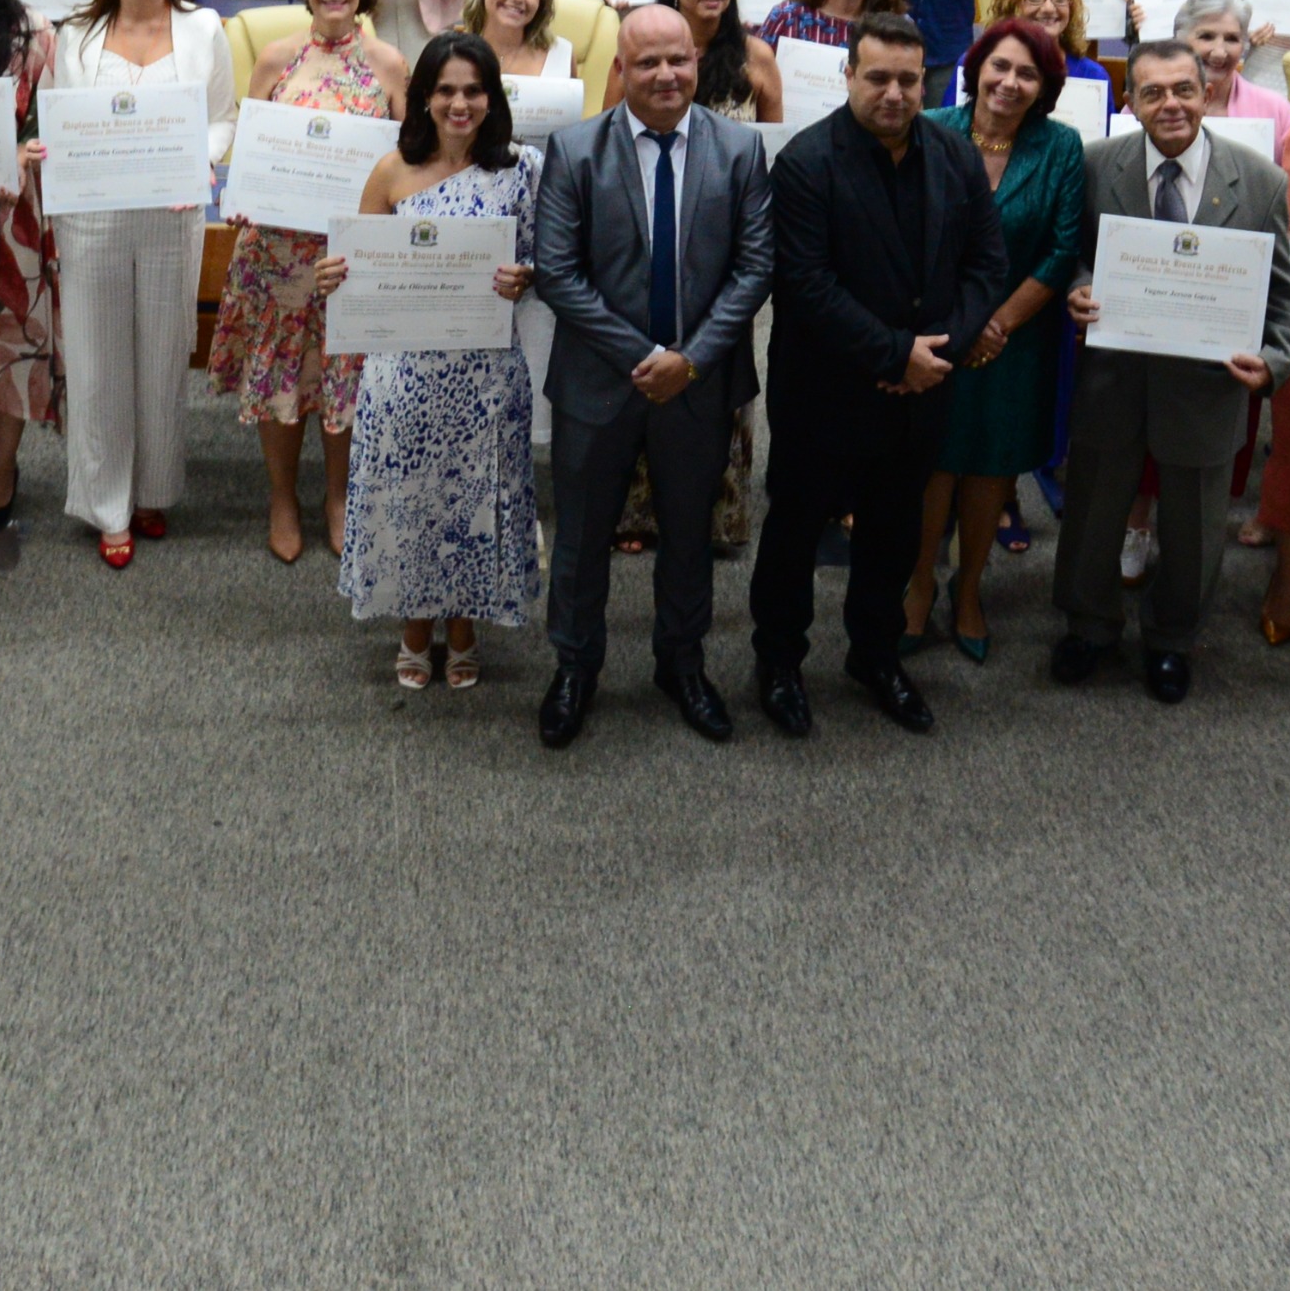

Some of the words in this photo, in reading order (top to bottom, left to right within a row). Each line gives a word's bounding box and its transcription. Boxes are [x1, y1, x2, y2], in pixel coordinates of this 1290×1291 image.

[62, 119, 98, 129] Diploma
[113, 117, 141, 126] Honra
[157, 115, 186, 124] Mérito
[256, 133, 292, 146] Diploma
[305, 141, 332, 152] Honra
[354, 249, 394, 259] Diploma
[398, 250, 407, 258] de
[411, 250, 442, 259] Honra
[459, 251, 492, 260] Mérito
[1120, 252, 1158, 265] Diploma
[1173, 259, 1201, 269] Honra
[1217, 263, 1248, 275] Mérito
[408, 282, 437, 290] Oliveira
[439, 283, 464, 291] Borges
